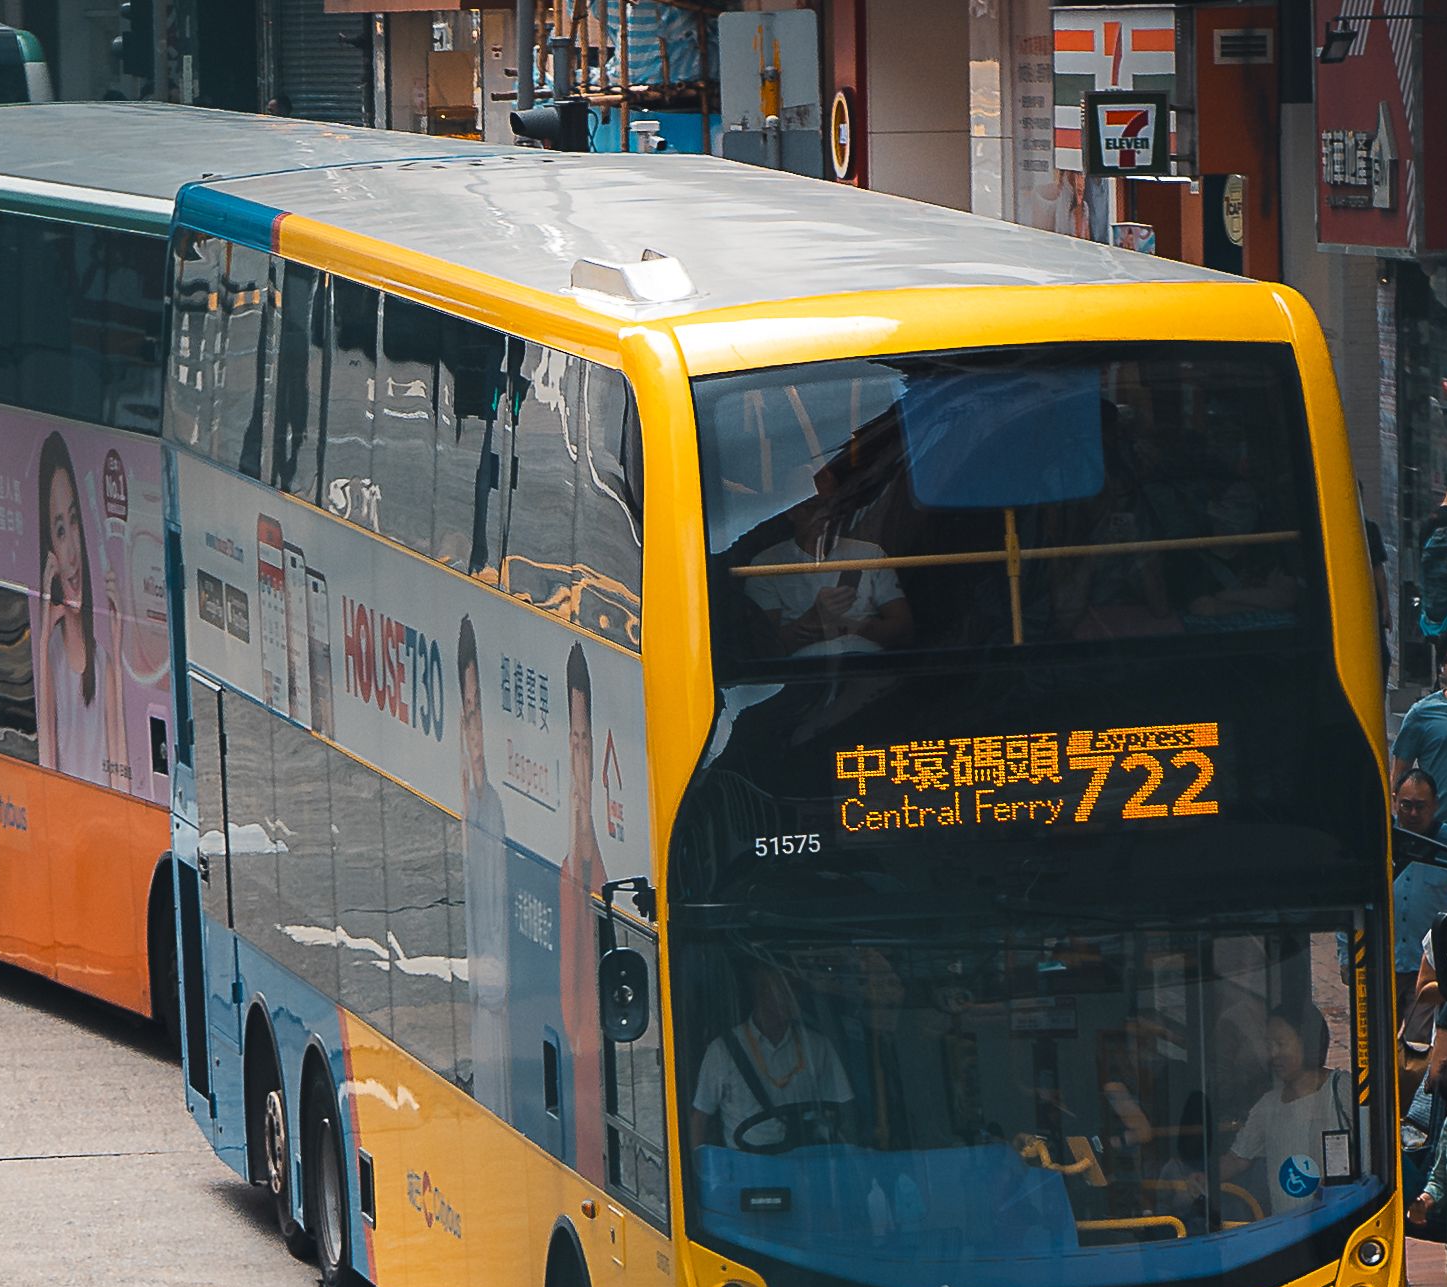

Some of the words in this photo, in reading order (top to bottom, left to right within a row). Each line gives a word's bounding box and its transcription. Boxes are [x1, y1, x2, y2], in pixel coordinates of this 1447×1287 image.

[835, 732, 1064, 796] 中環碼頭
[1067, 750, 1220, 823] 722
[840, 793, 963, 832] Central
[975, 789, 1064, 825] Ferry
[754, 833, 822, 857] 51575
